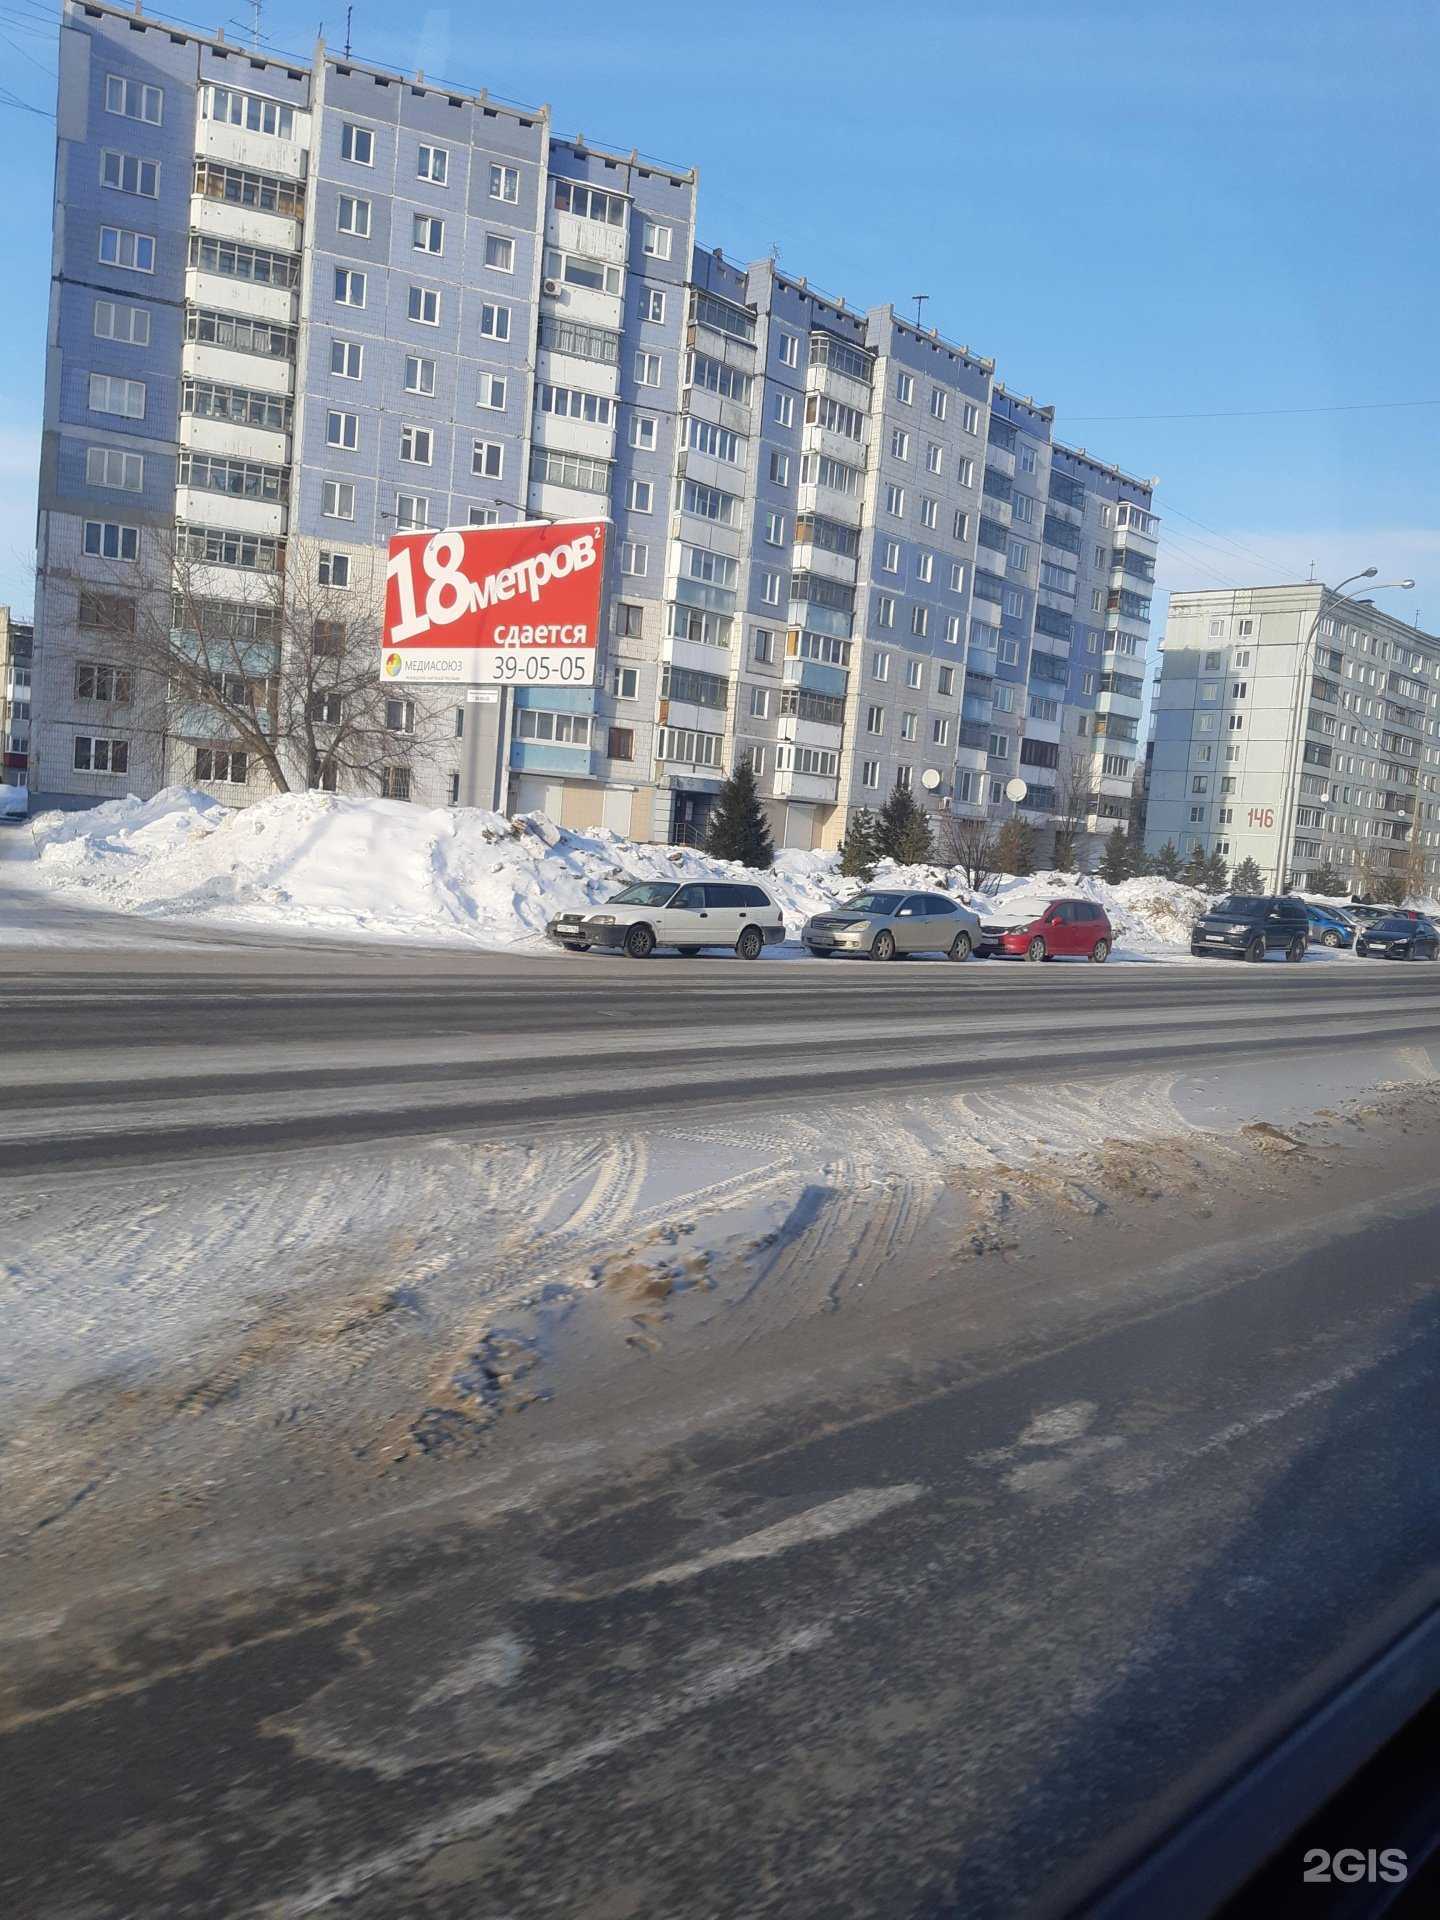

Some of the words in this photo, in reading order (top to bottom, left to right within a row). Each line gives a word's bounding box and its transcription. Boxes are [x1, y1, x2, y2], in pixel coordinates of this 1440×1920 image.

[387, 533, 471, 644] 18
[493, 624, 587, 650] сдается
[404, 659, 463, 672] МЕДИАСОЮЗ
[492, 655, 586, 681] 39-05-05
[1247, 807, 1274, 828] 146
